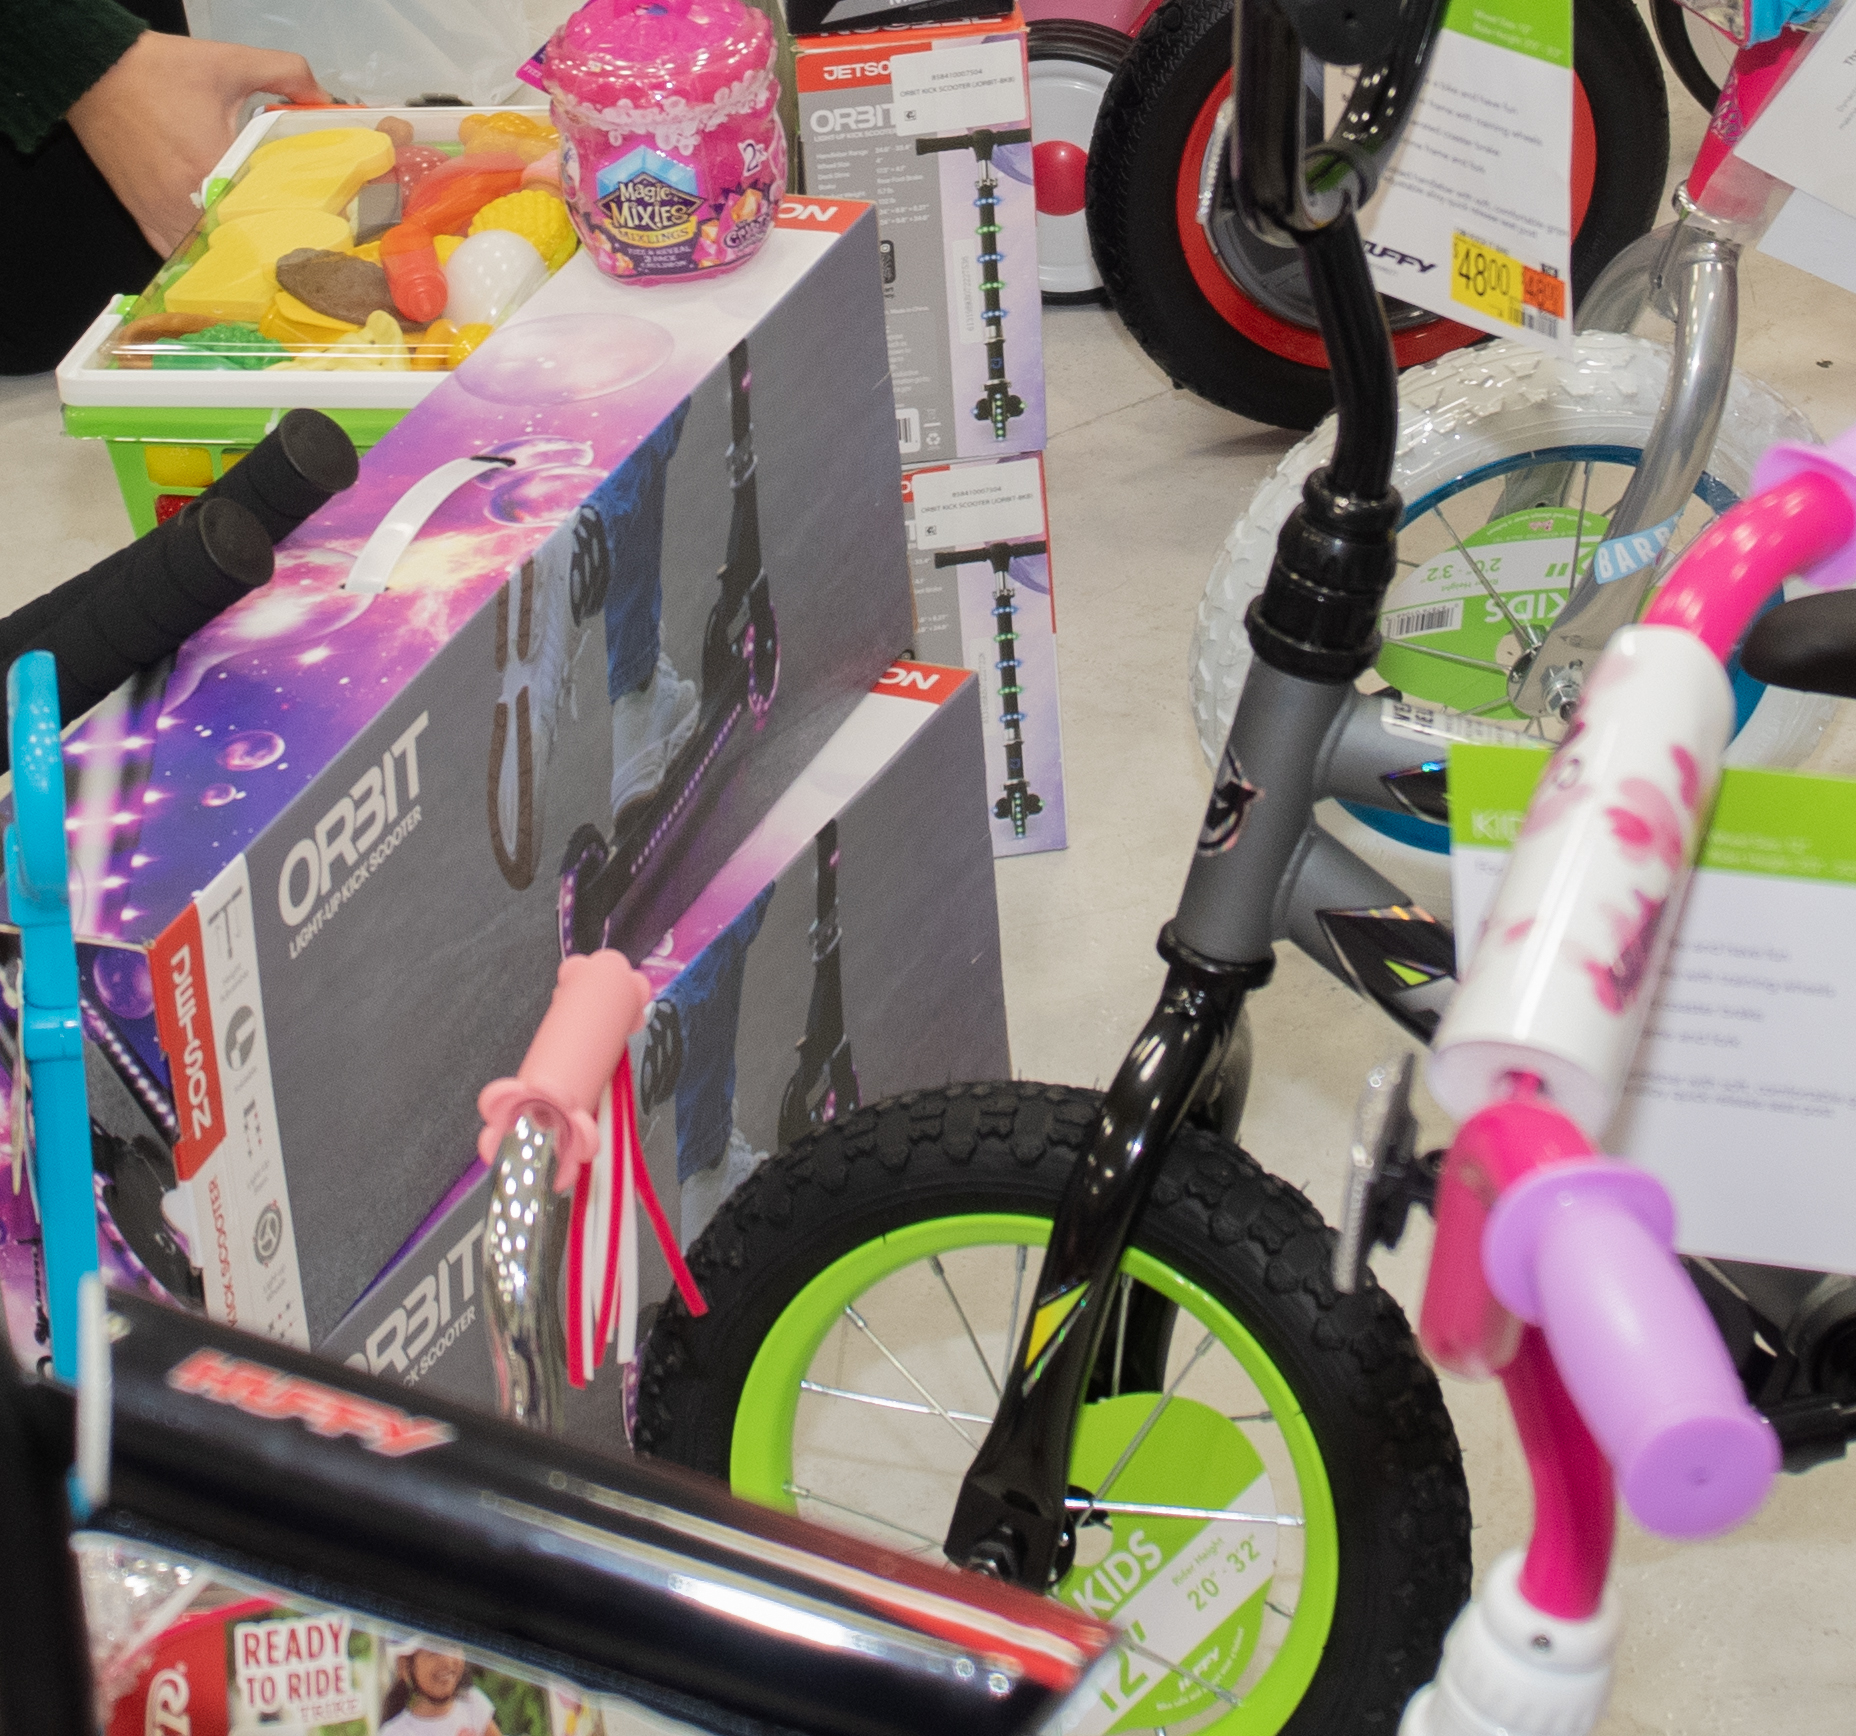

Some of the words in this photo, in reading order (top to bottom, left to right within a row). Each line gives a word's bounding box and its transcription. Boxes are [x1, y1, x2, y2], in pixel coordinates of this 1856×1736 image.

[822, 60, 892, 81] JETSO
[899, 89, 920, 97] ORBIT
[921, 86, 937, 94] KICK
[938, 82, 971, 92] SCOOTER
[618, 178, 671, 205] Magic
[616, 223, 689, 246] MIXLINGS
[920, 505, 941, 513] ORBIT
[942, 503, 958, 511] KICK
[958, 498, 990, 509] SCOOTER
[1482, 580, 1568, 633] KIDS
[278, 710, 431, 928] ORBIT
[289, 887, 343, 959] LIGHT-UP
[342, 856, 373, 905] KICK
[374, 806, 423, 873] SCOOTER
[168, 945, 216, 1140] JETSON
[205, 1176, 236, 1276] SCOOTER
[416, 1303, 481, 1373] SCOOTER
[166, 1347, 460, 1459] HUFFY
[1065, 1526, 1171, 1621] KIDS
[1168, 1559, 1200, 1588] Rider
[1191, 1534, 1228, 1567] Height
[1181, 1569, 1228, 1613] 2'0"
[1221, 1531, 1269, 1576] 3'2"
[240, 1619, 345, 1669] READY
[245, 1675, 279, 1707] TO
[285, 1665, 348, 1699] RIDE
[297, 1696, 362, 1723] TRIKE
